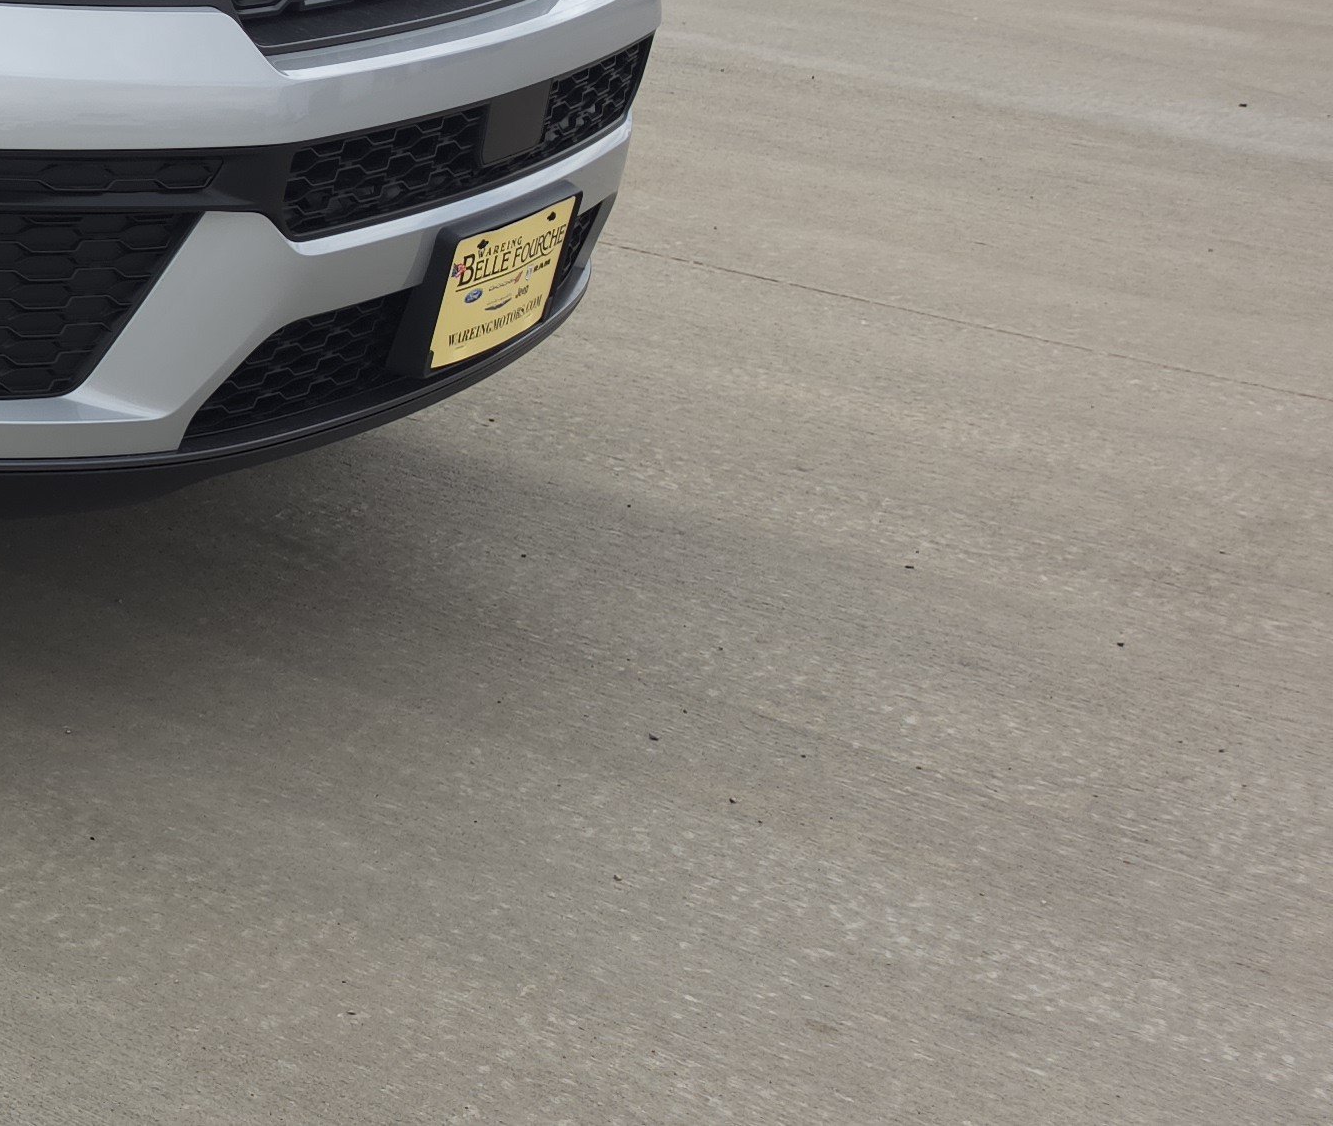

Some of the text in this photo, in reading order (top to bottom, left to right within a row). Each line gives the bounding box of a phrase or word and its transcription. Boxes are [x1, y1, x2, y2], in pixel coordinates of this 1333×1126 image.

[457, 224, 567, 287] BELLE FOURCHE
[478, 235, 523, 259] WAREING
[533, 258, 551, 272] RAM
